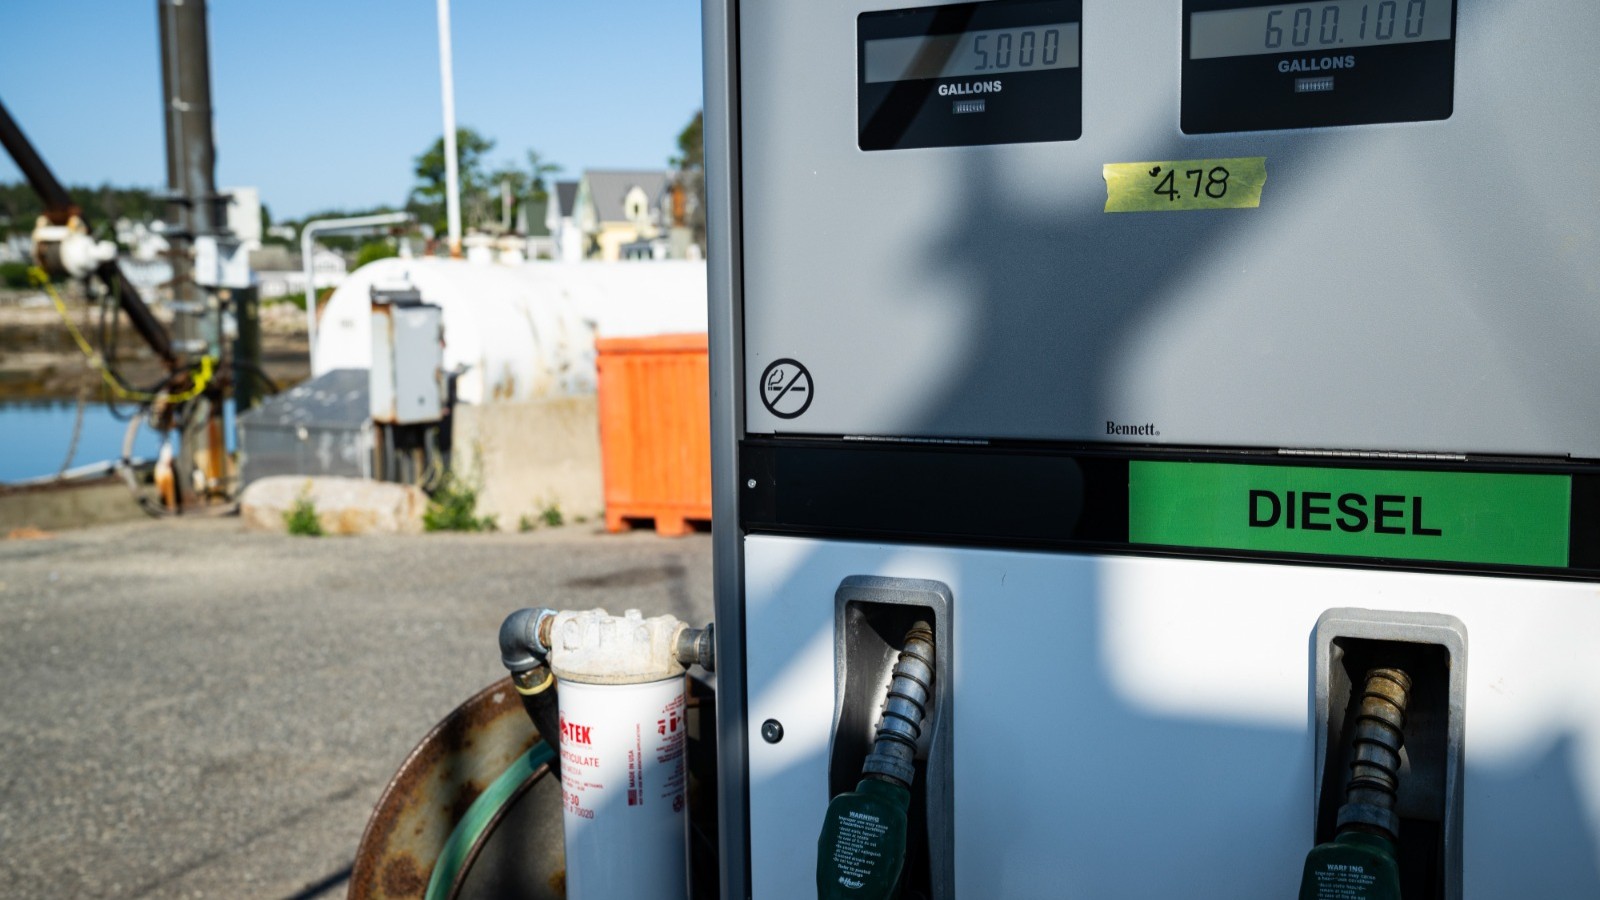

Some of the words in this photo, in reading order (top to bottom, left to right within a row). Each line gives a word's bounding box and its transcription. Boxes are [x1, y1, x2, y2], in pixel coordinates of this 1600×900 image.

[1265, 0, 1426, 48] 600.100
[974, 29, 1059, 70] 5.000
[1278, 55, 1355, 72] GALLONS
[938, 80, 1002, 96] GALLONS
[1248, 489, 1443, 537] DIESEL
[568, 722, 591, 745] TEK
[849, 811, 880, 823] WARNING
